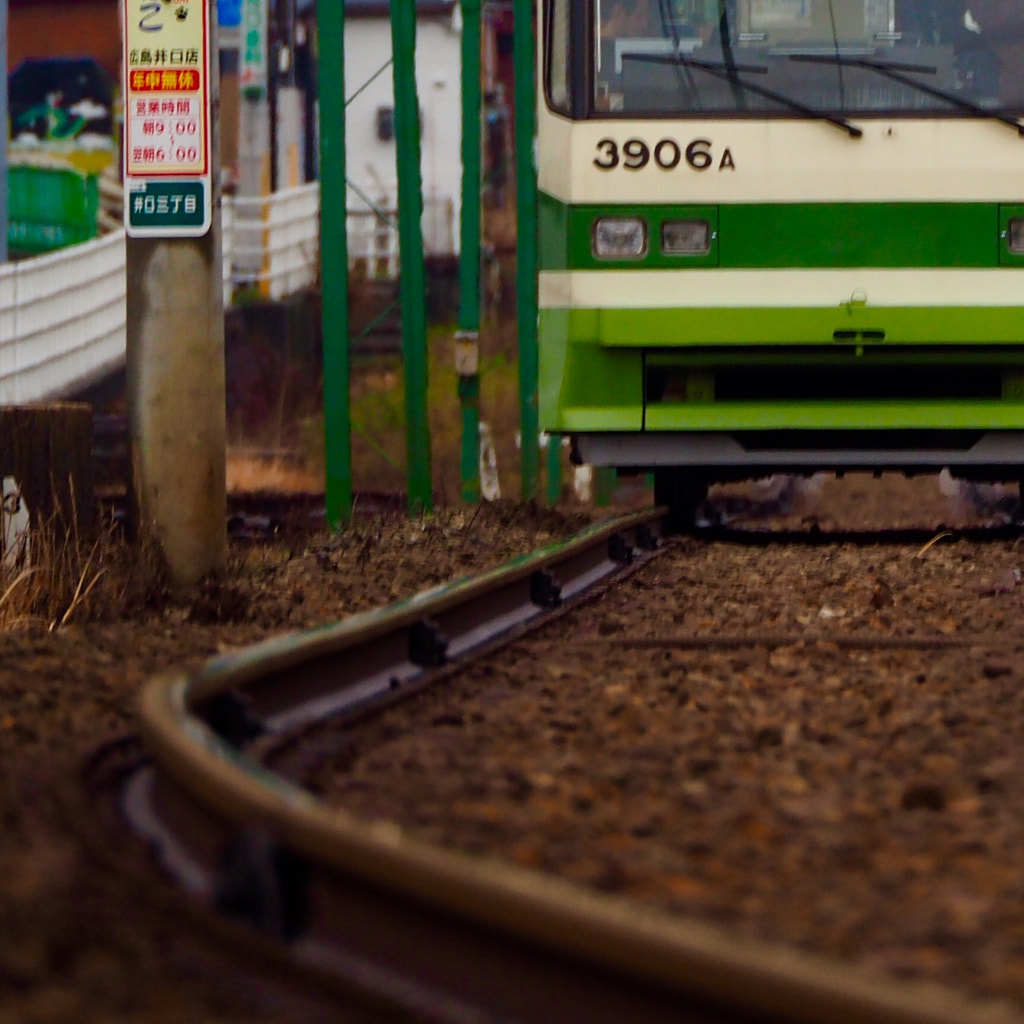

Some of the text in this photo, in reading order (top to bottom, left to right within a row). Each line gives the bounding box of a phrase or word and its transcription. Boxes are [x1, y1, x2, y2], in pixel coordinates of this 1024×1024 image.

[130, 48, 199, 66] 広島井口店
[132, 71, 194, 91] 年中無休
[136, 99, 190, 117] 営業時間
